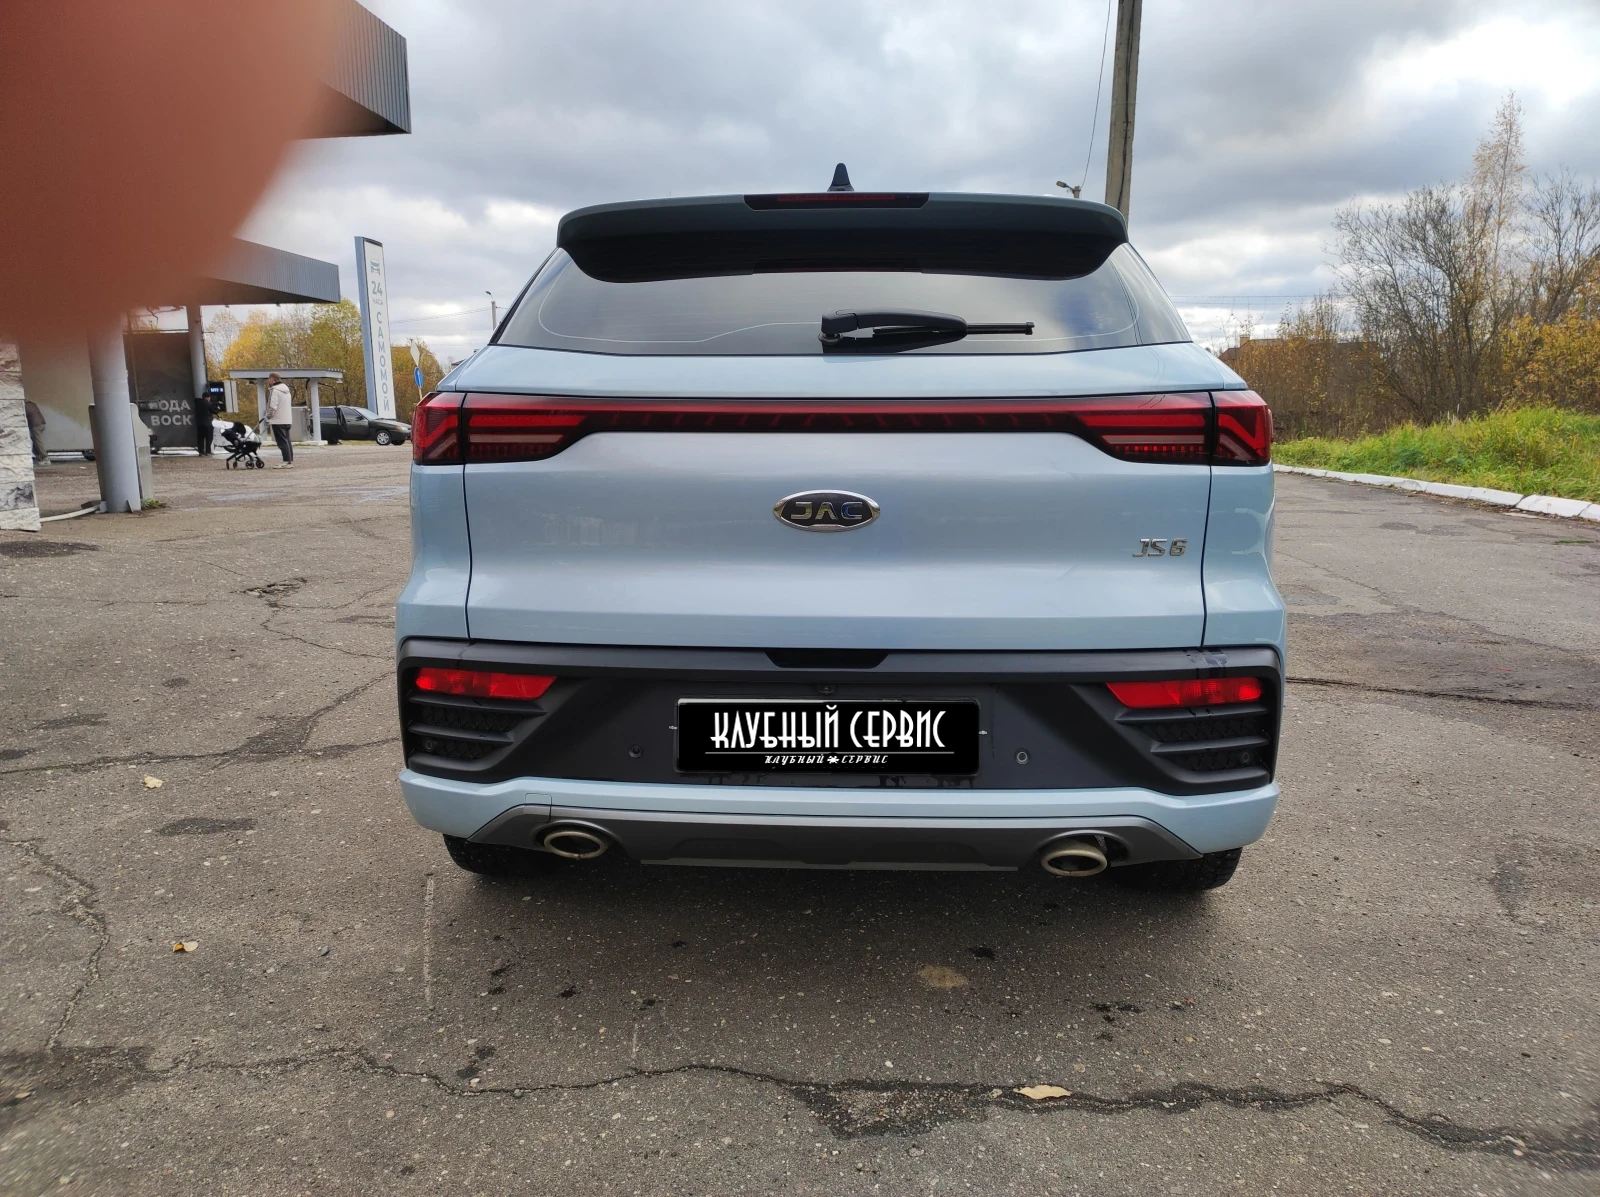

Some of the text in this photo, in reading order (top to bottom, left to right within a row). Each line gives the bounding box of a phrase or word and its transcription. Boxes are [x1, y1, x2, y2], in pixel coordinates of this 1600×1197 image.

[371, 280, 383, 296] 24
[376, 311, 390, 412] САМОМОЙ
[150, 414, 193, 426] ВОСК
[790, 501, 863, 520] JAC
[1132, 538, 1188, 557] JS6
